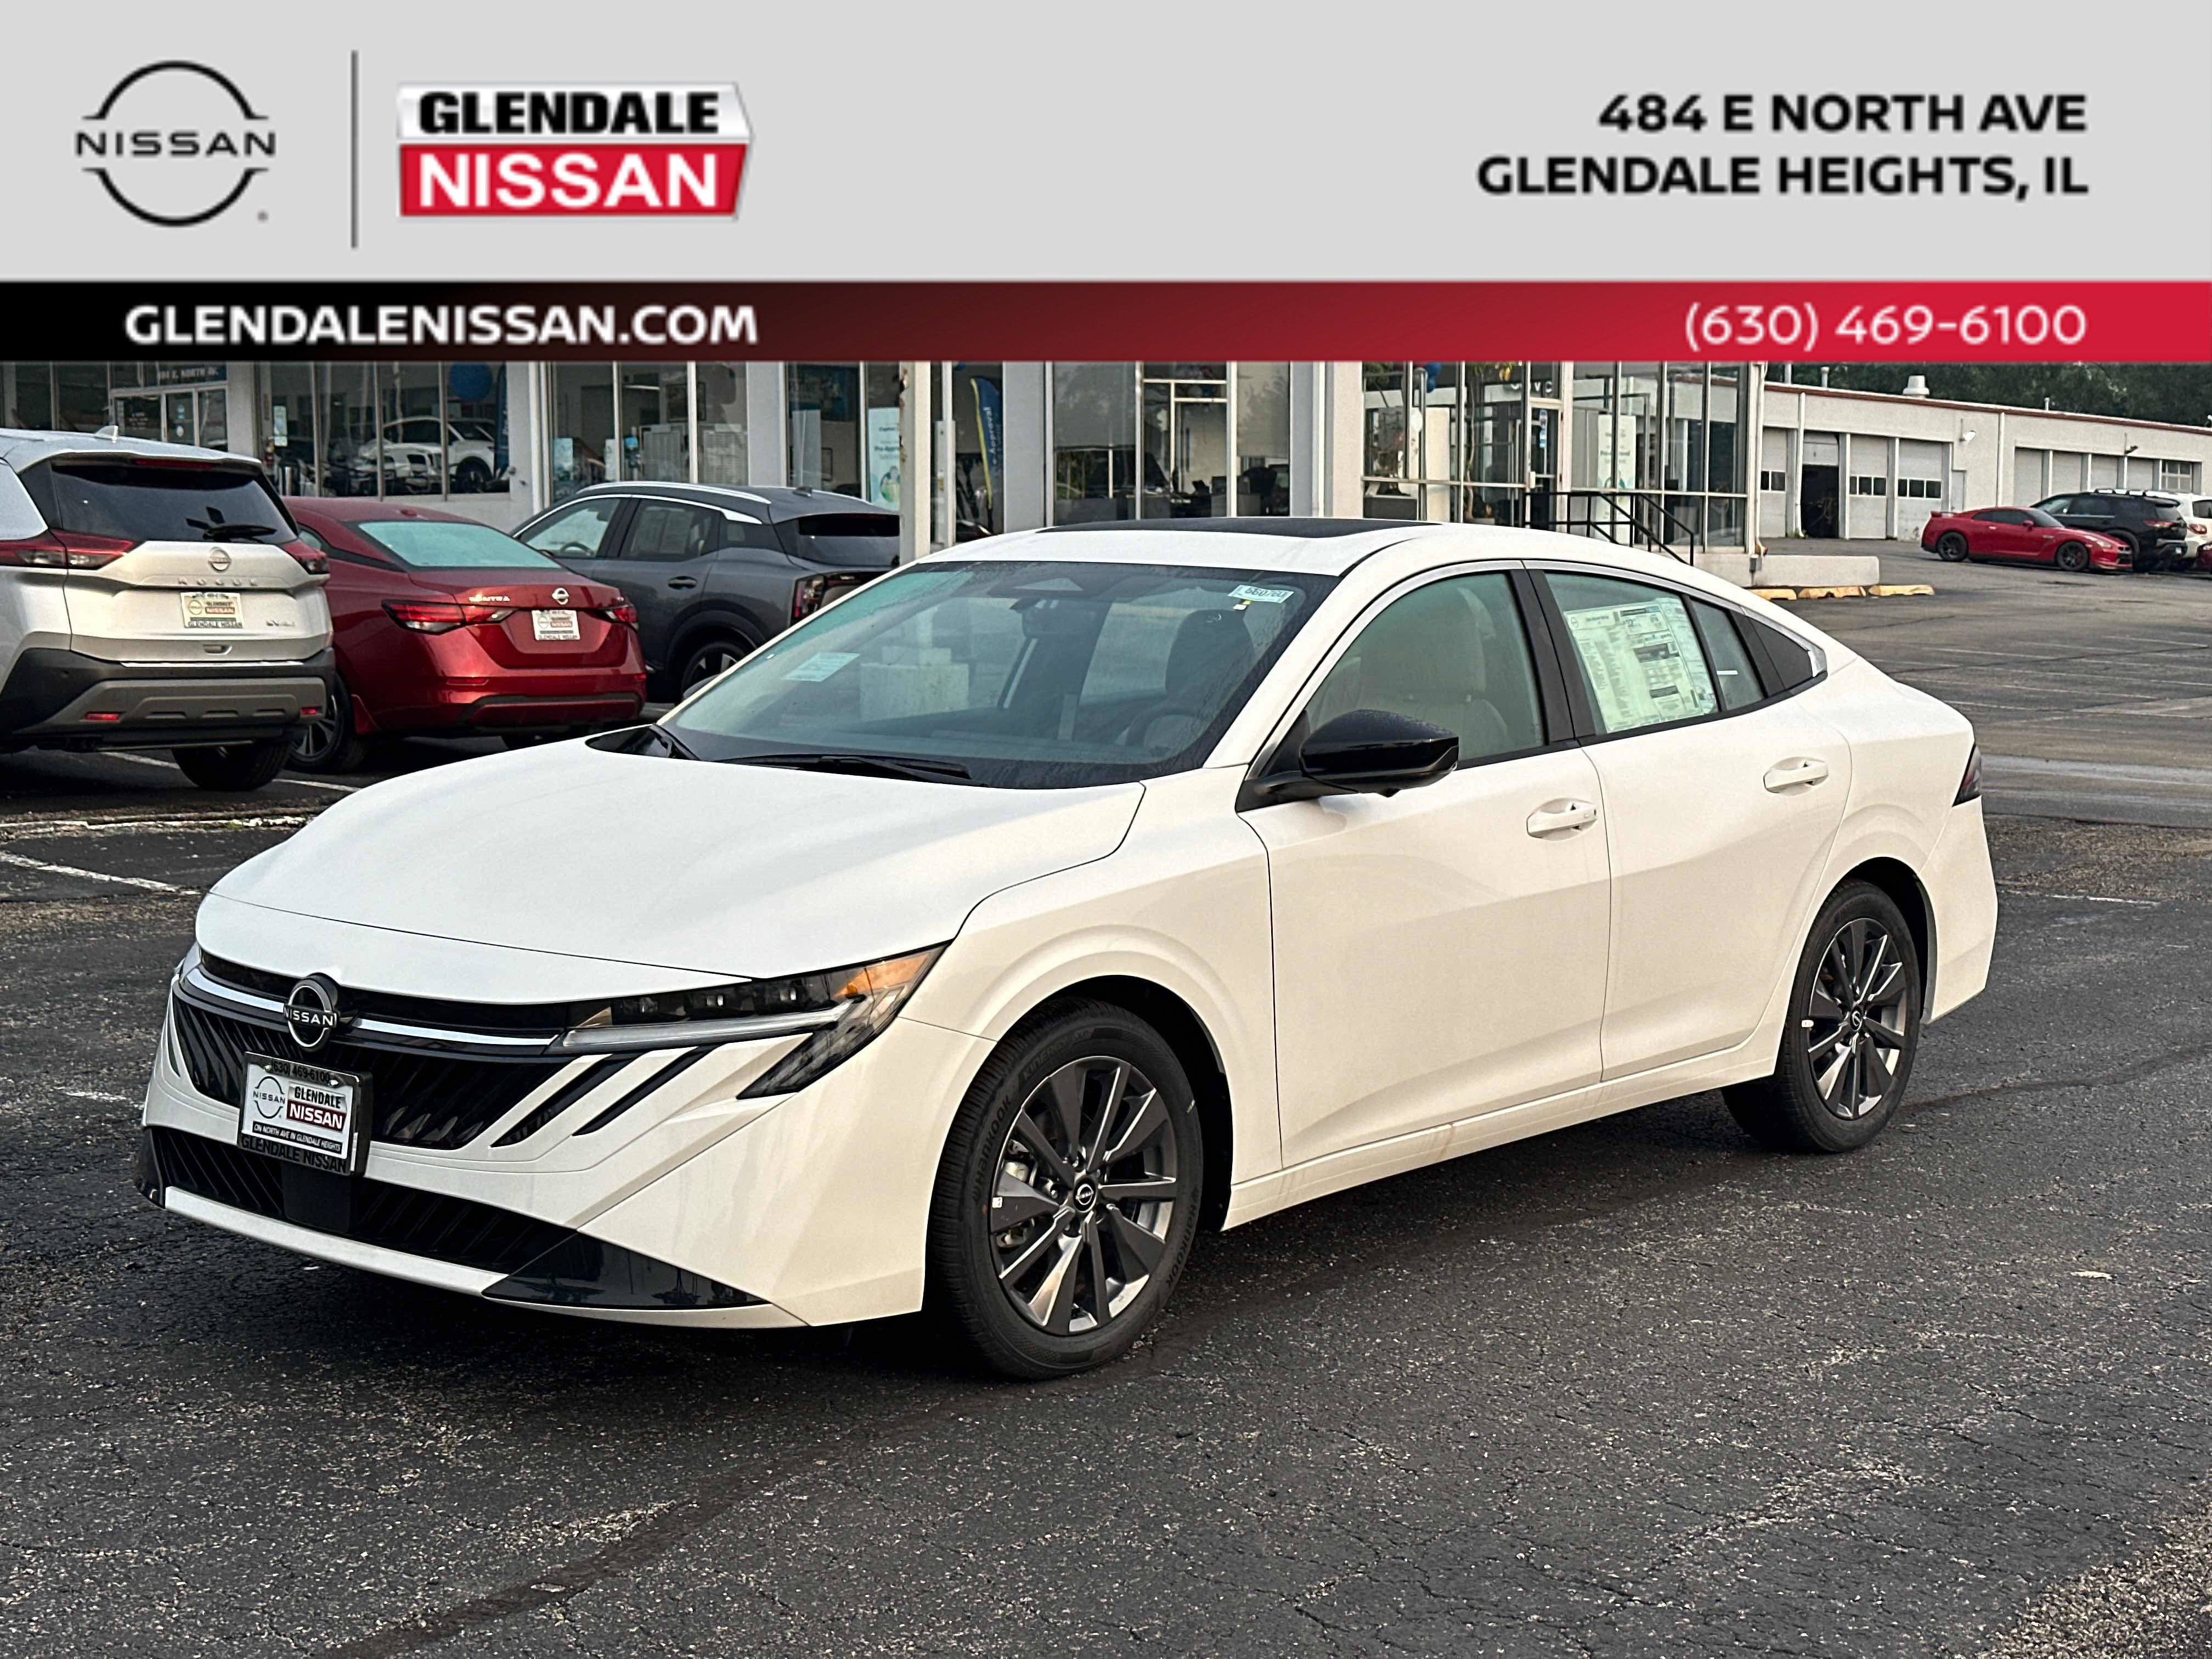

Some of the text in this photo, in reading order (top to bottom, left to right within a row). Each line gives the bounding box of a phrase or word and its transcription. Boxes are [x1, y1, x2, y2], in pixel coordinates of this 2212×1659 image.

[177, 578, 258, 586] ROGUE
[283, 1006, 334, 1026] NISSAN
[292, 1065, 330, 1083] 469-6100
[253, 1091, 285, 1104] NISSAN
[294, 1086, 341, 1109] GLENDALE
[289, 1103, 343, 1129] NISSAN
[253, 1124, 262, 1132] ON
[262, 1126, 280, 1136] NORTH
[280, 1130, 290, 1139] AVE
[296, 1133, 321, 1146] GLENDALE
[321, 1140, 341, 1152] HEIGHTS
[242, 1136, 346, 1173] GLENDALE NISSAN
